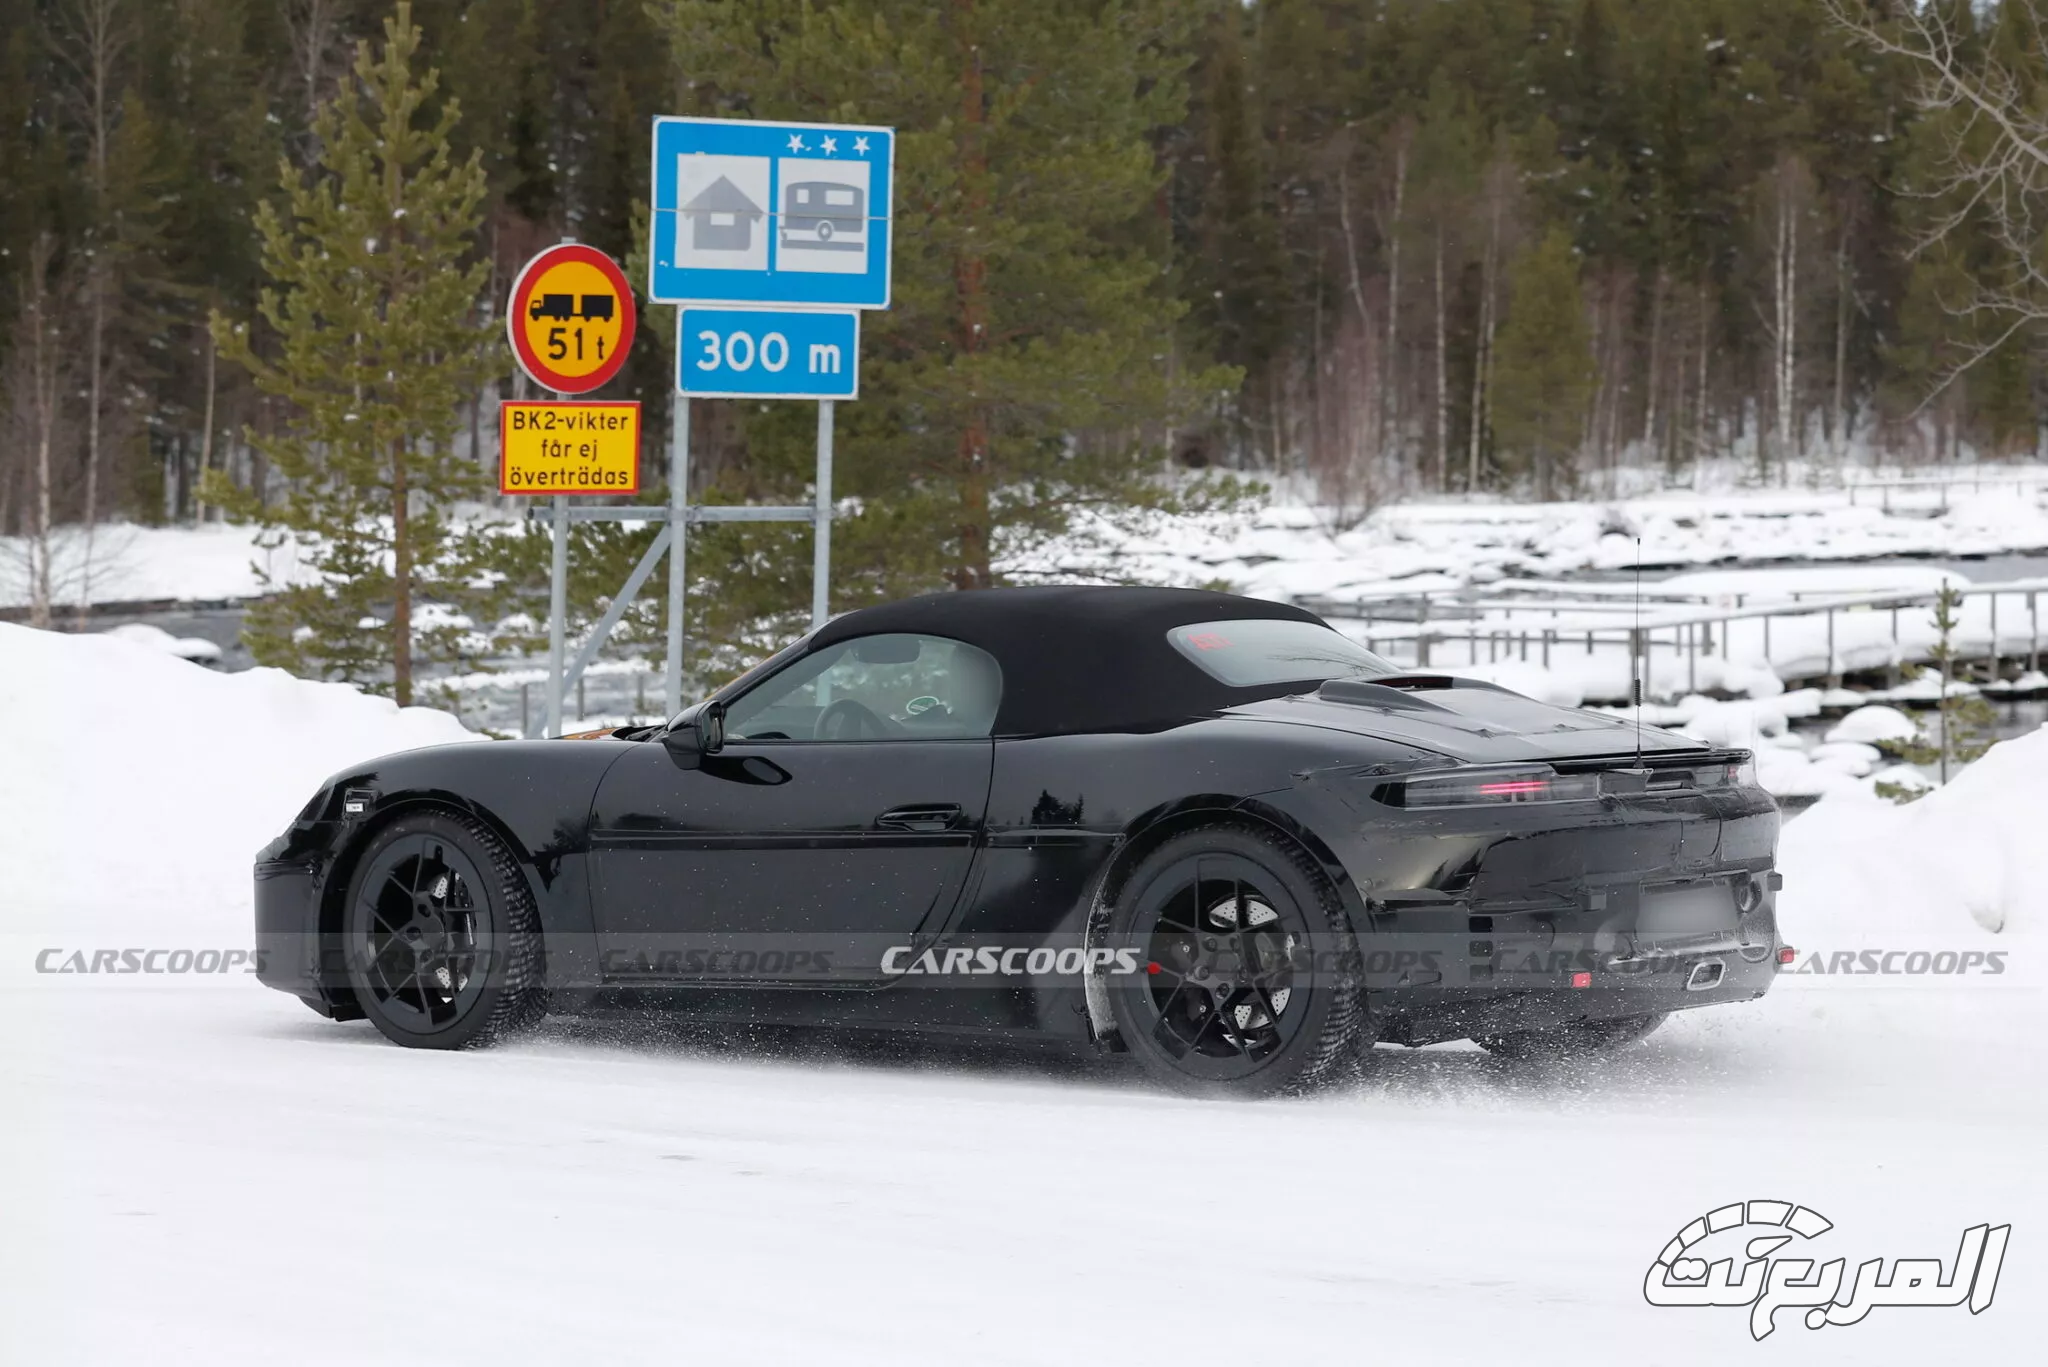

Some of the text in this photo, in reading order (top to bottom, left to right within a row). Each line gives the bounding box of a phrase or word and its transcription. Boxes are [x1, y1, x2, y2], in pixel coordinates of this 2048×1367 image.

[548, 328, 604, 360] 51 t
[696, 330, 841, 374] 300 m
[513, 411, 628, 431] BK2-vikter
[541, 439, 598, 462] får ej
[510, 467, 628, 486] överträdas
